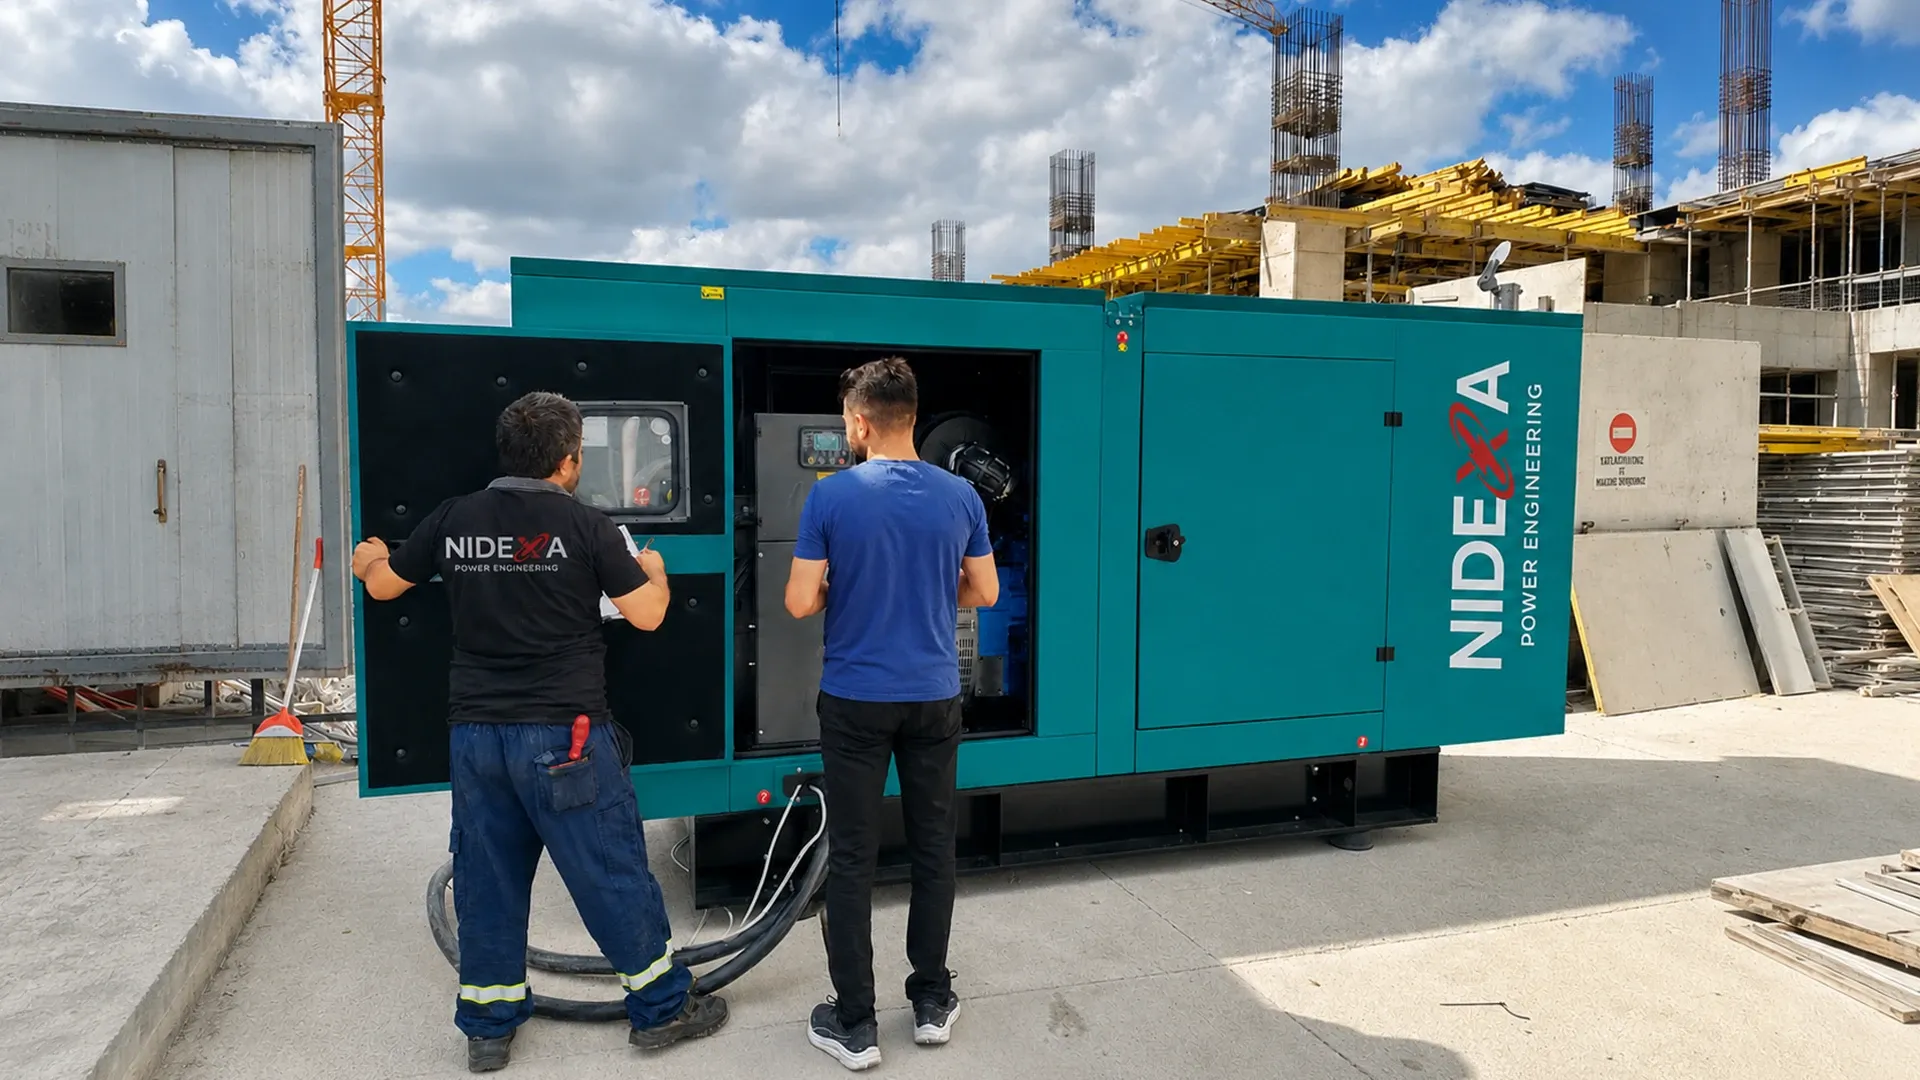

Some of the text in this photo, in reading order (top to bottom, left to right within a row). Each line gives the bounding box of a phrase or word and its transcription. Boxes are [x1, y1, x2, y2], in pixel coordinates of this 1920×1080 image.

[445, 532, 568, 563] NIDEXA
[454, 564, 559, 573] POWER ENGINEERING
[1449, 360, 1515, 670] NIDEXA
[1521, 383, 1542, 646] POWER ENGINEERING
